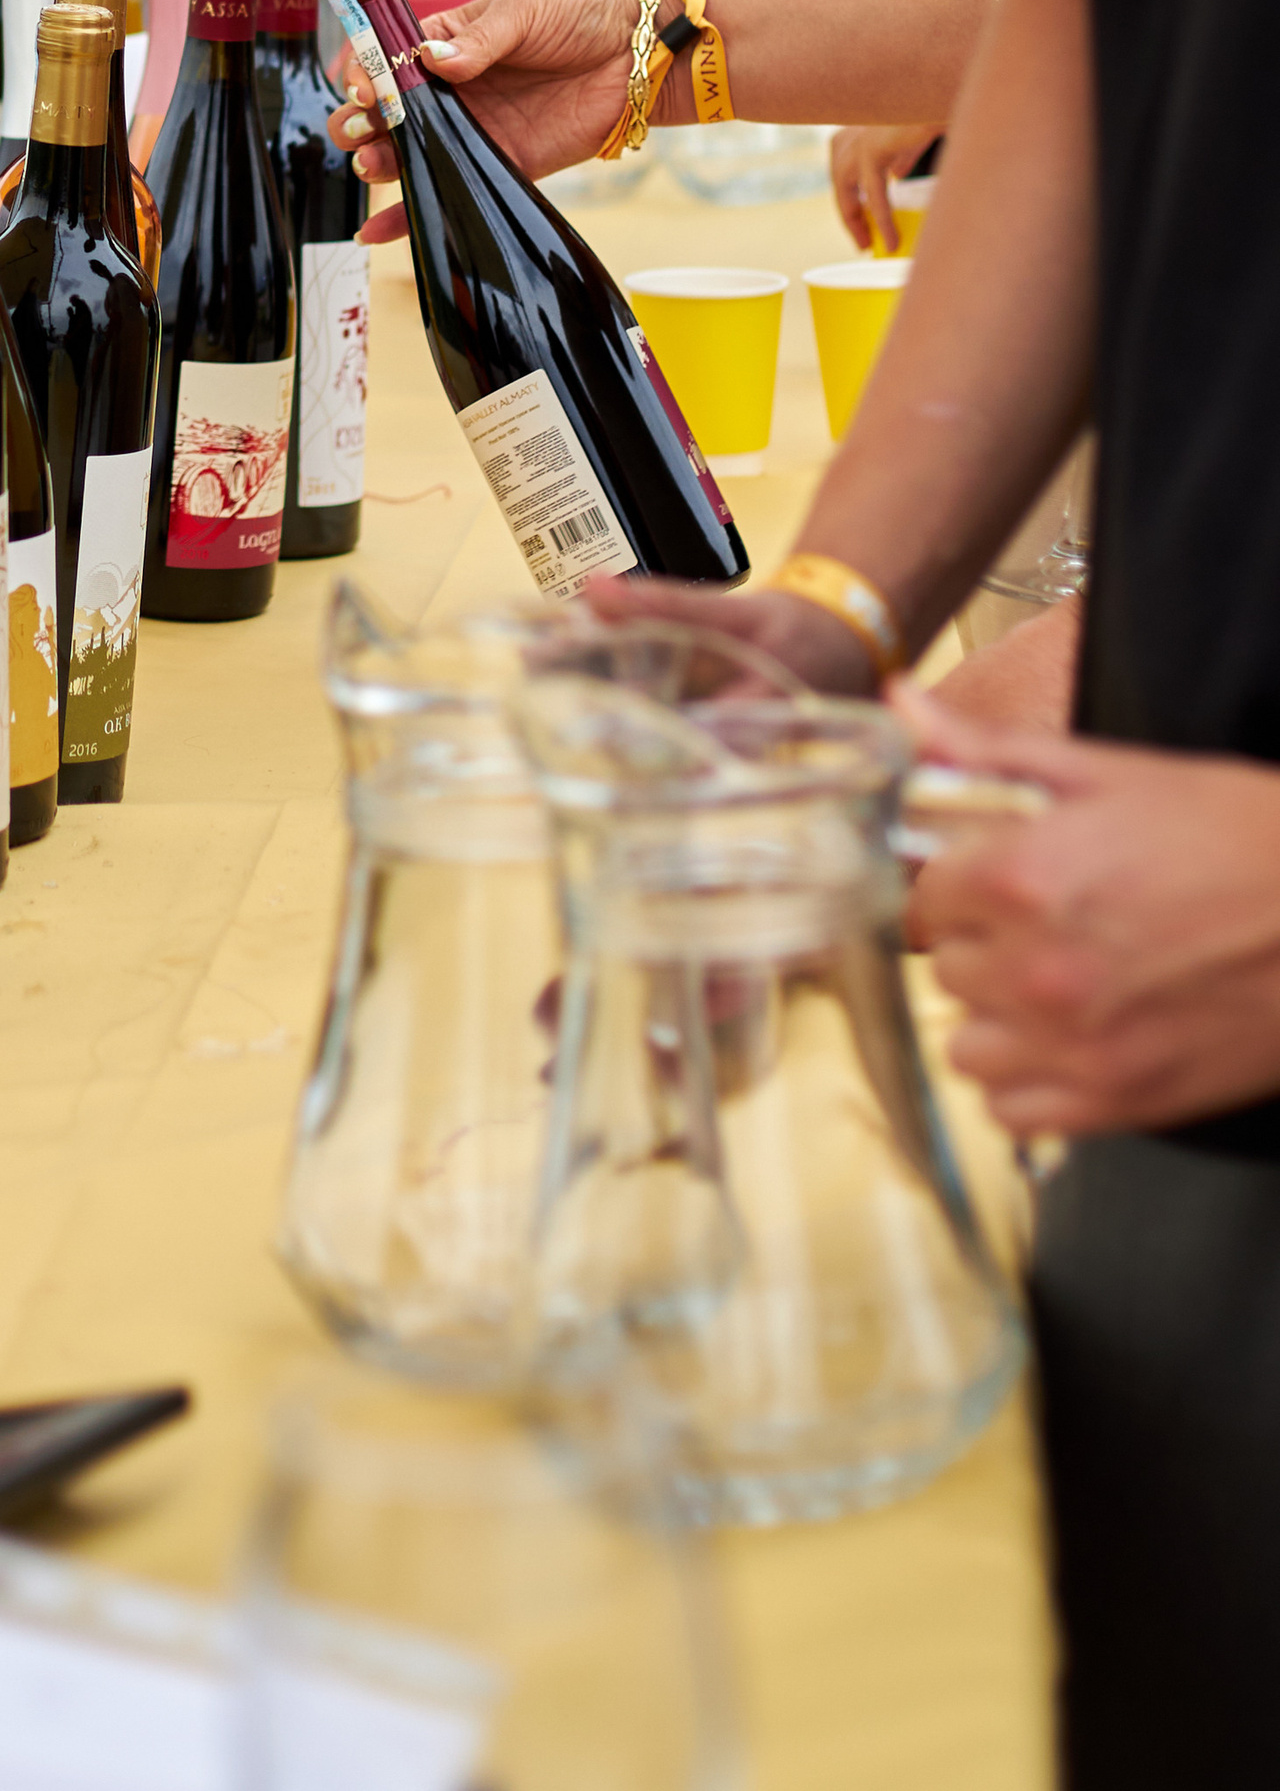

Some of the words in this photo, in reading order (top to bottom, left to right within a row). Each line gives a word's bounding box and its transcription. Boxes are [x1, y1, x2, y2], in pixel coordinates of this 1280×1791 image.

[699, 35, 720, 103] WINE
[498, 381, 540, 409] ALMATY
[68, 742, 98, 757] 2016
